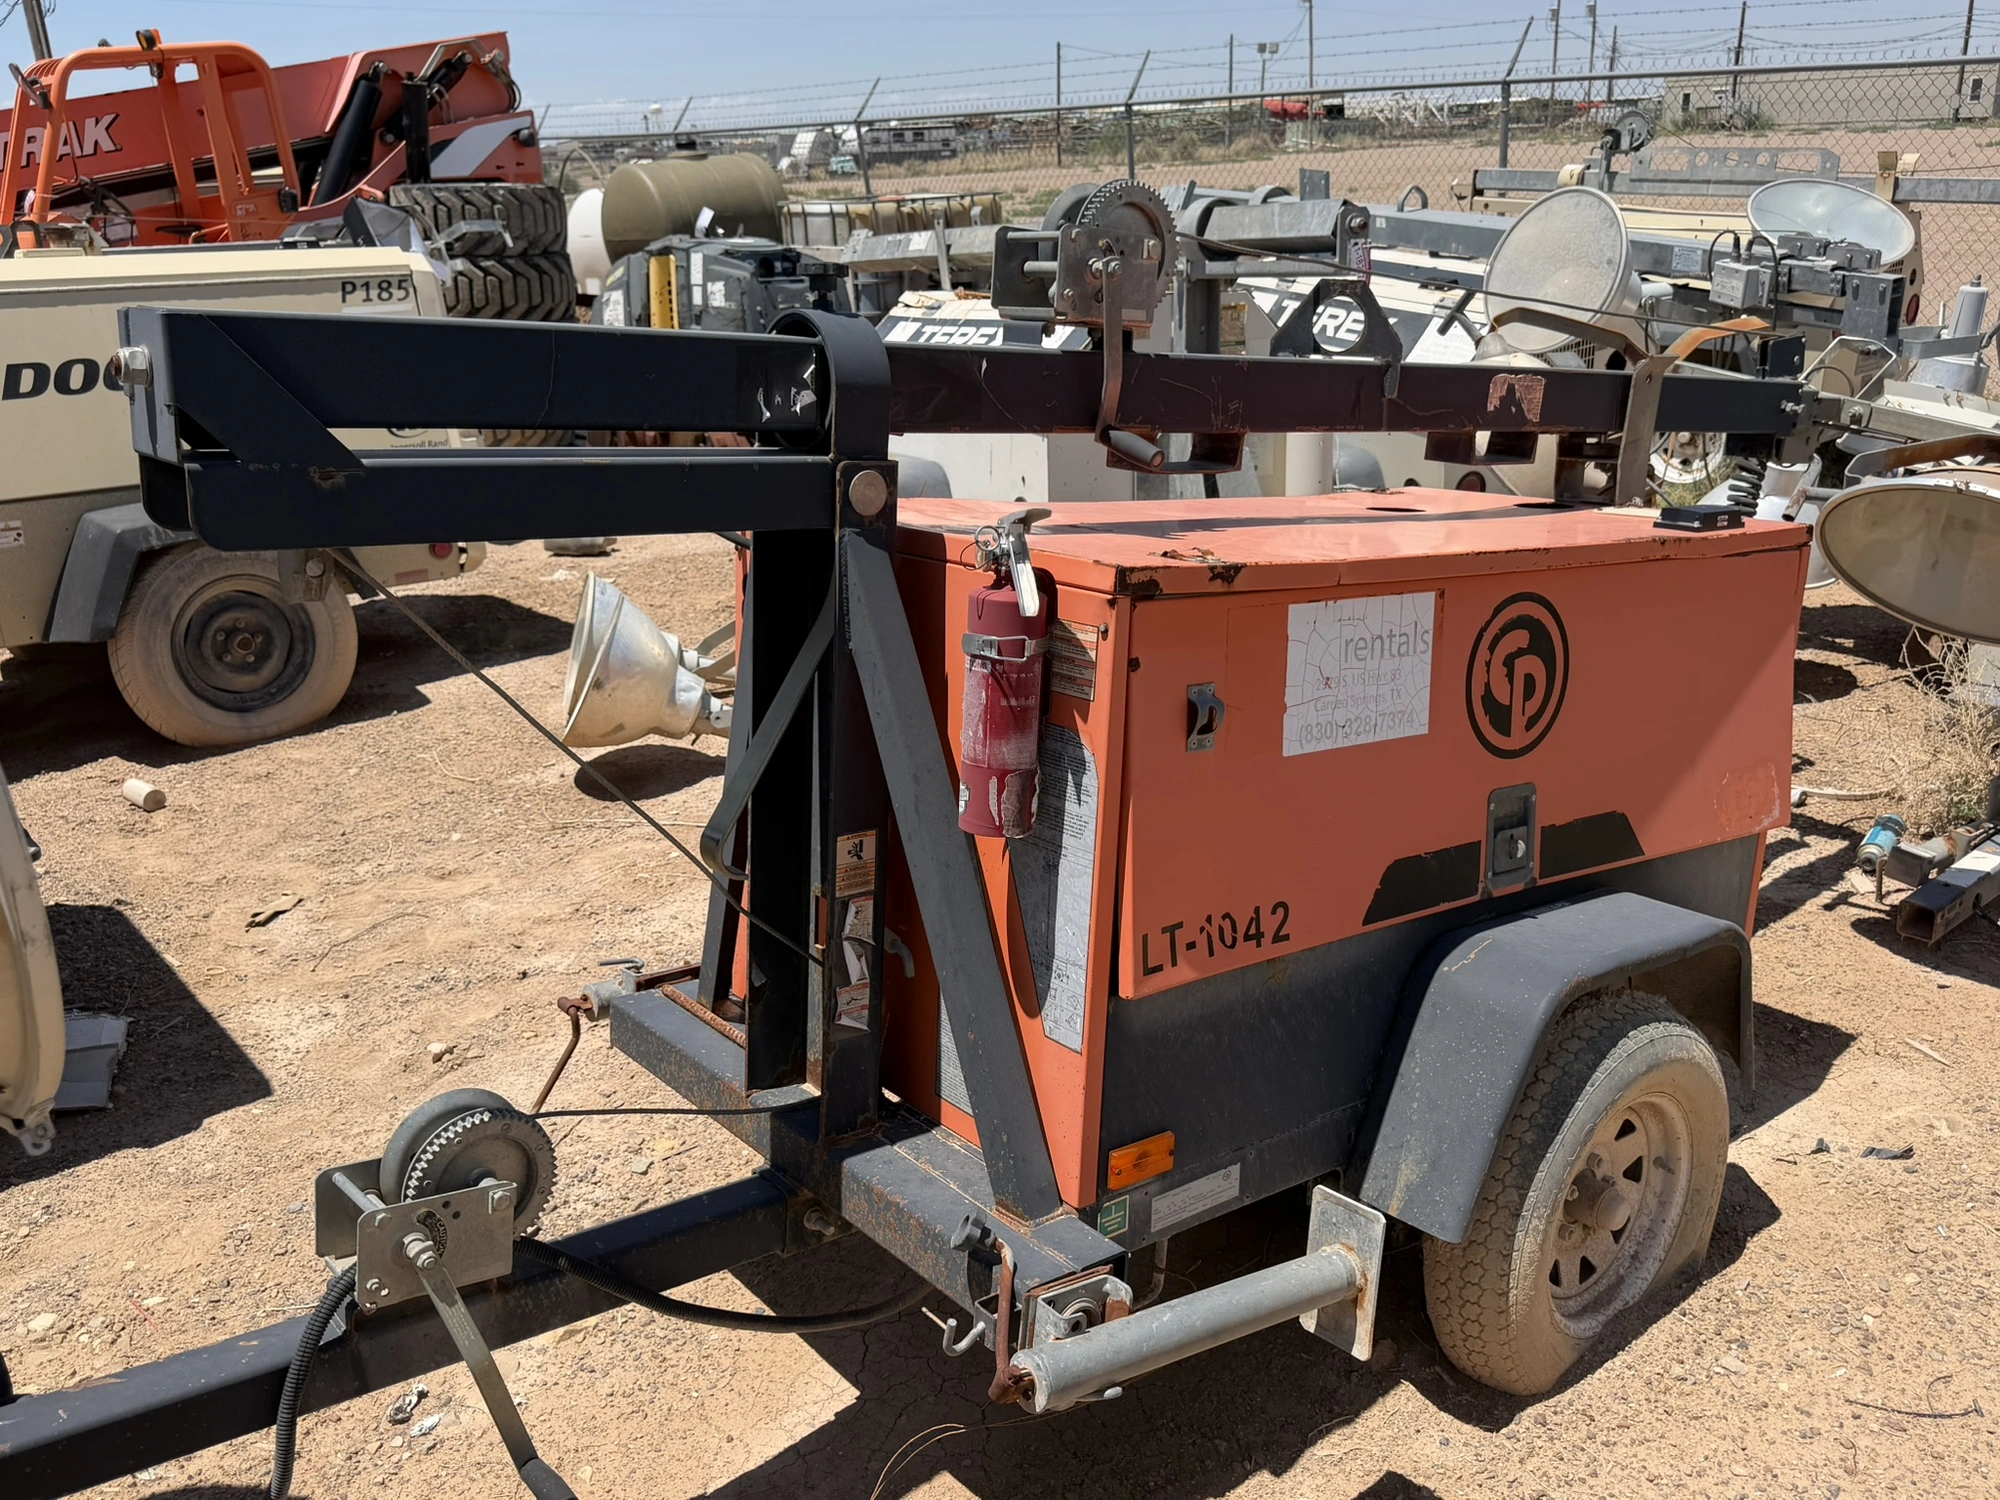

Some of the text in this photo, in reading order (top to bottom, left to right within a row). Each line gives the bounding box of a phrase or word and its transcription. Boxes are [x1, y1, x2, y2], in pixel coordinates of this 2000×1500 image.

[341, 279, 410, 304] P185
[1344, 621, 1430, 663] rentals
[1352, 673, 1365, 687] US
[1390, 668, 1402, 681] 83
[1390, 688, 1402, 701] TX
[1300, 709, 1415, 749] (830) 328-7374
[1142, 901, 1290, 977] LT-1042
